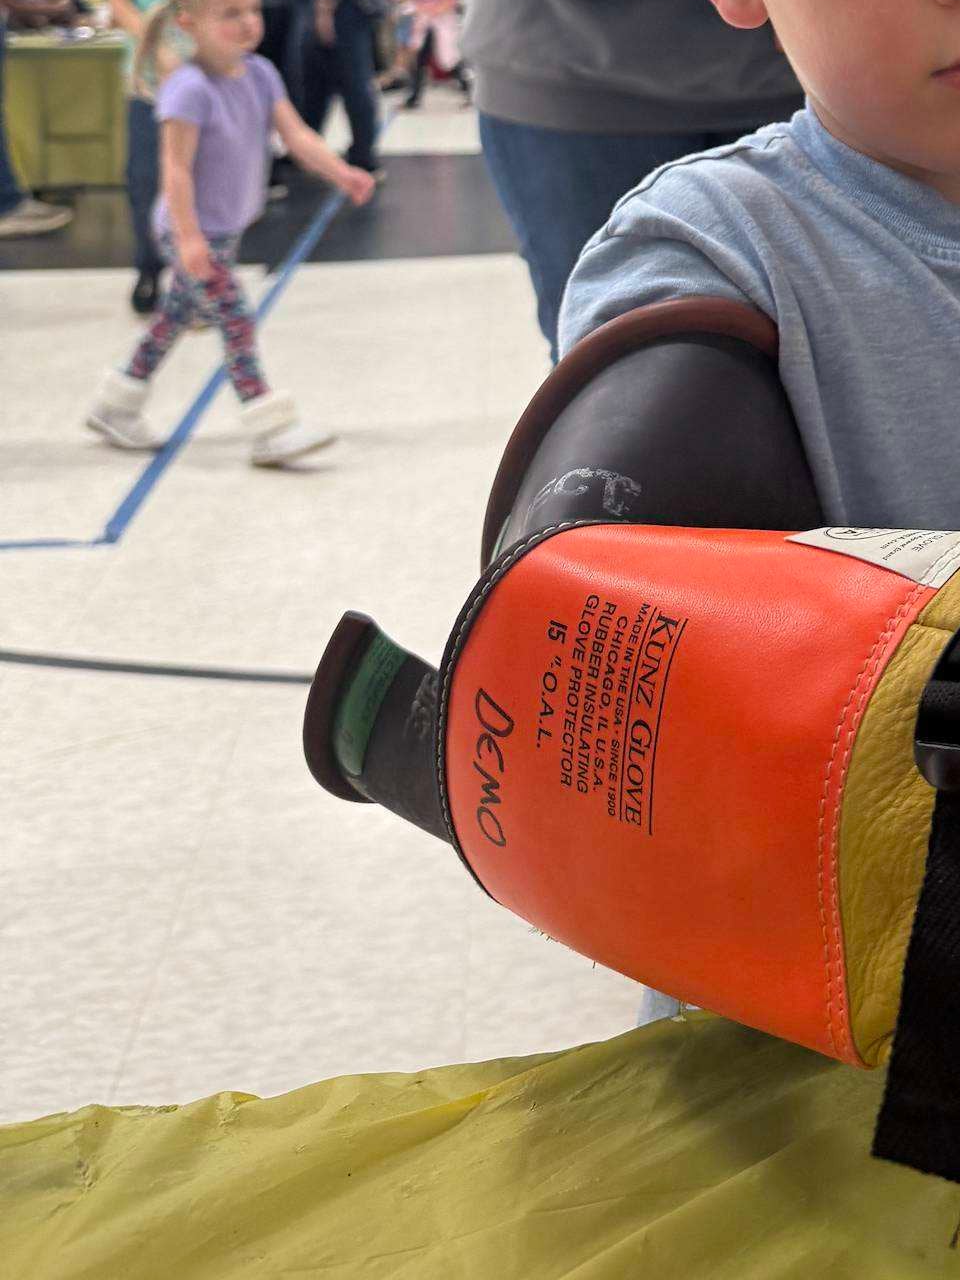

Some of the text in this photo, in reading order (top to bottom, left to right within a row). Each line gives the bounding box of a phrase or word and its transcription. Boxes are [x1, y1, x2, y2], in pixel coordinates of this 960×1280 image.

[548, 620, 568, 644] 15
[560, 594, 599, 787] GLOVE PROTECTOR
[577, 602, 616, 794] RUBBER INSULATING
[592, 616, 627, 792] CHICAGO, IL U.S.A.
[608, 603, 651, 816] MADE IN THE USA SINCE 1900
[626, 614, 678, 826] KUNZ GLOVE
